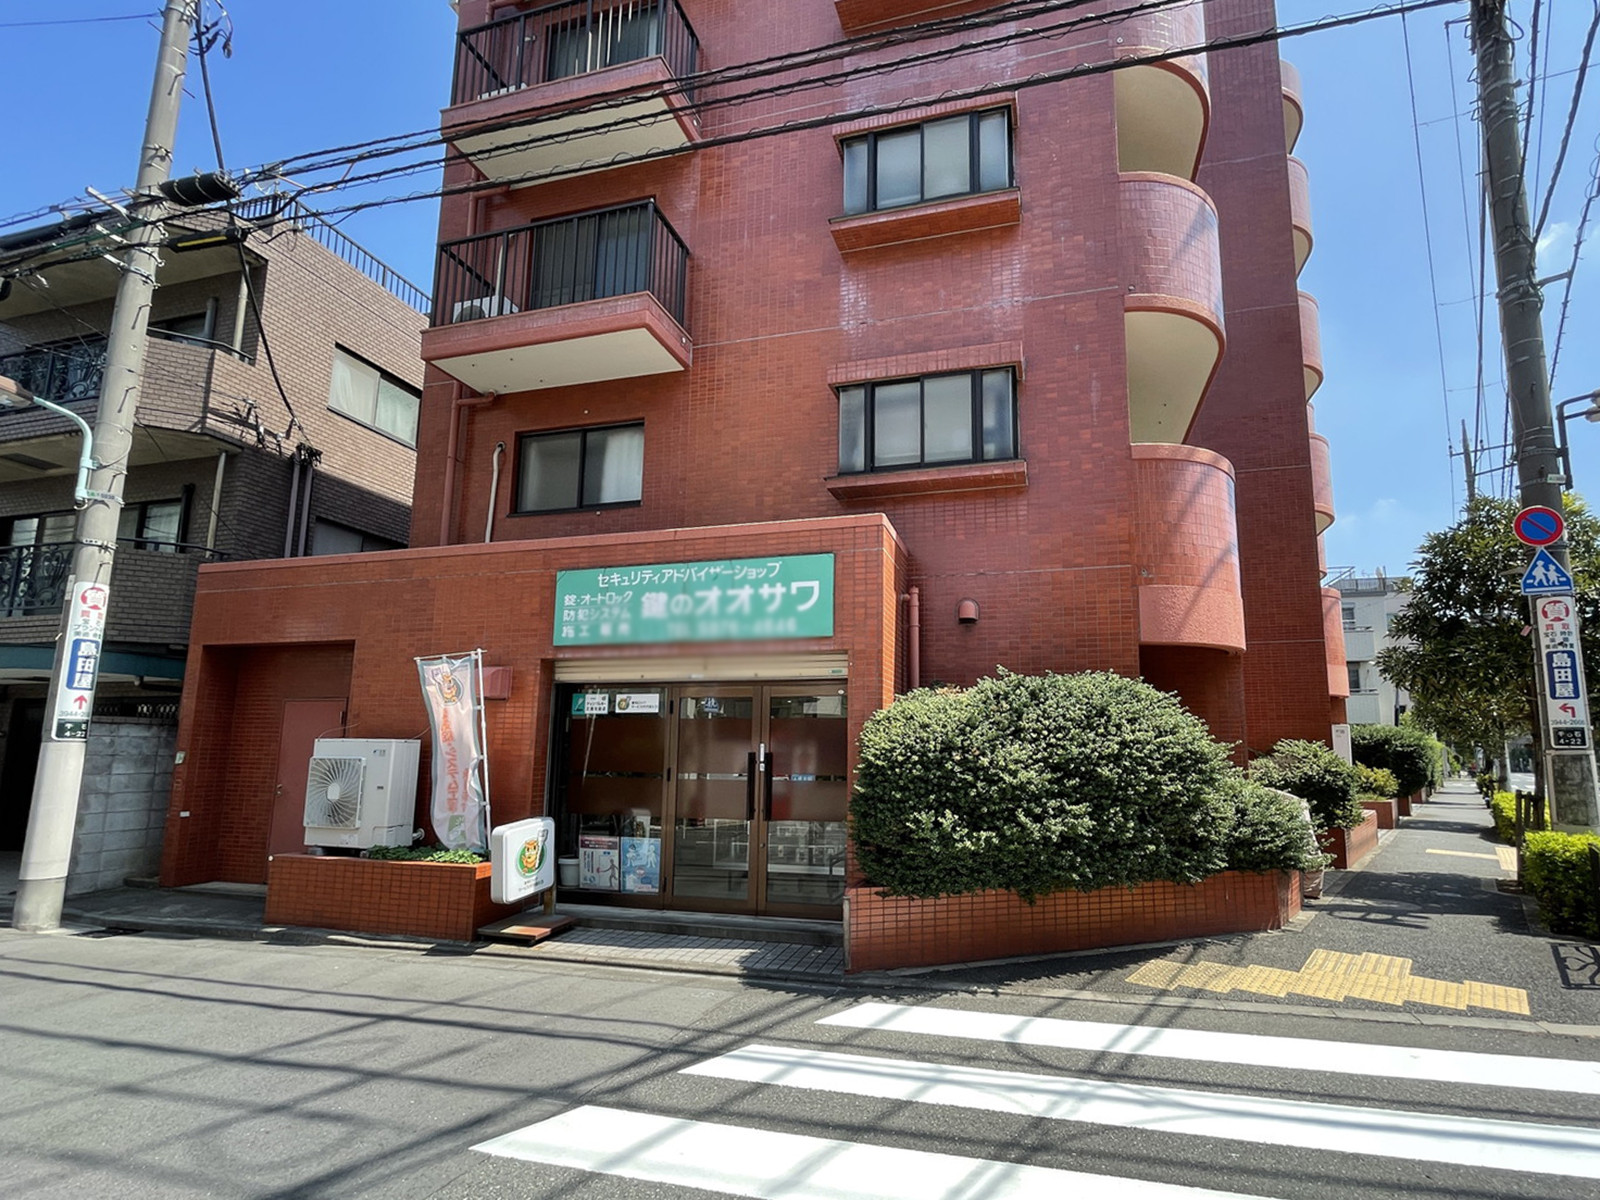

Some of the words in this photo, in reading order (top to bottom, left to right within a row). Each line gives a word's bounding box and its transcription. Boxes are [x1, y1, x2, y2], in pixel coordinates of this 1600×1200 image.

[597, 561, 783, 587] セキュリティアドバイザーショップ
[73, 642, 97, 688] 島田屋
[1552, 652, 1575, 698] 島田屋
